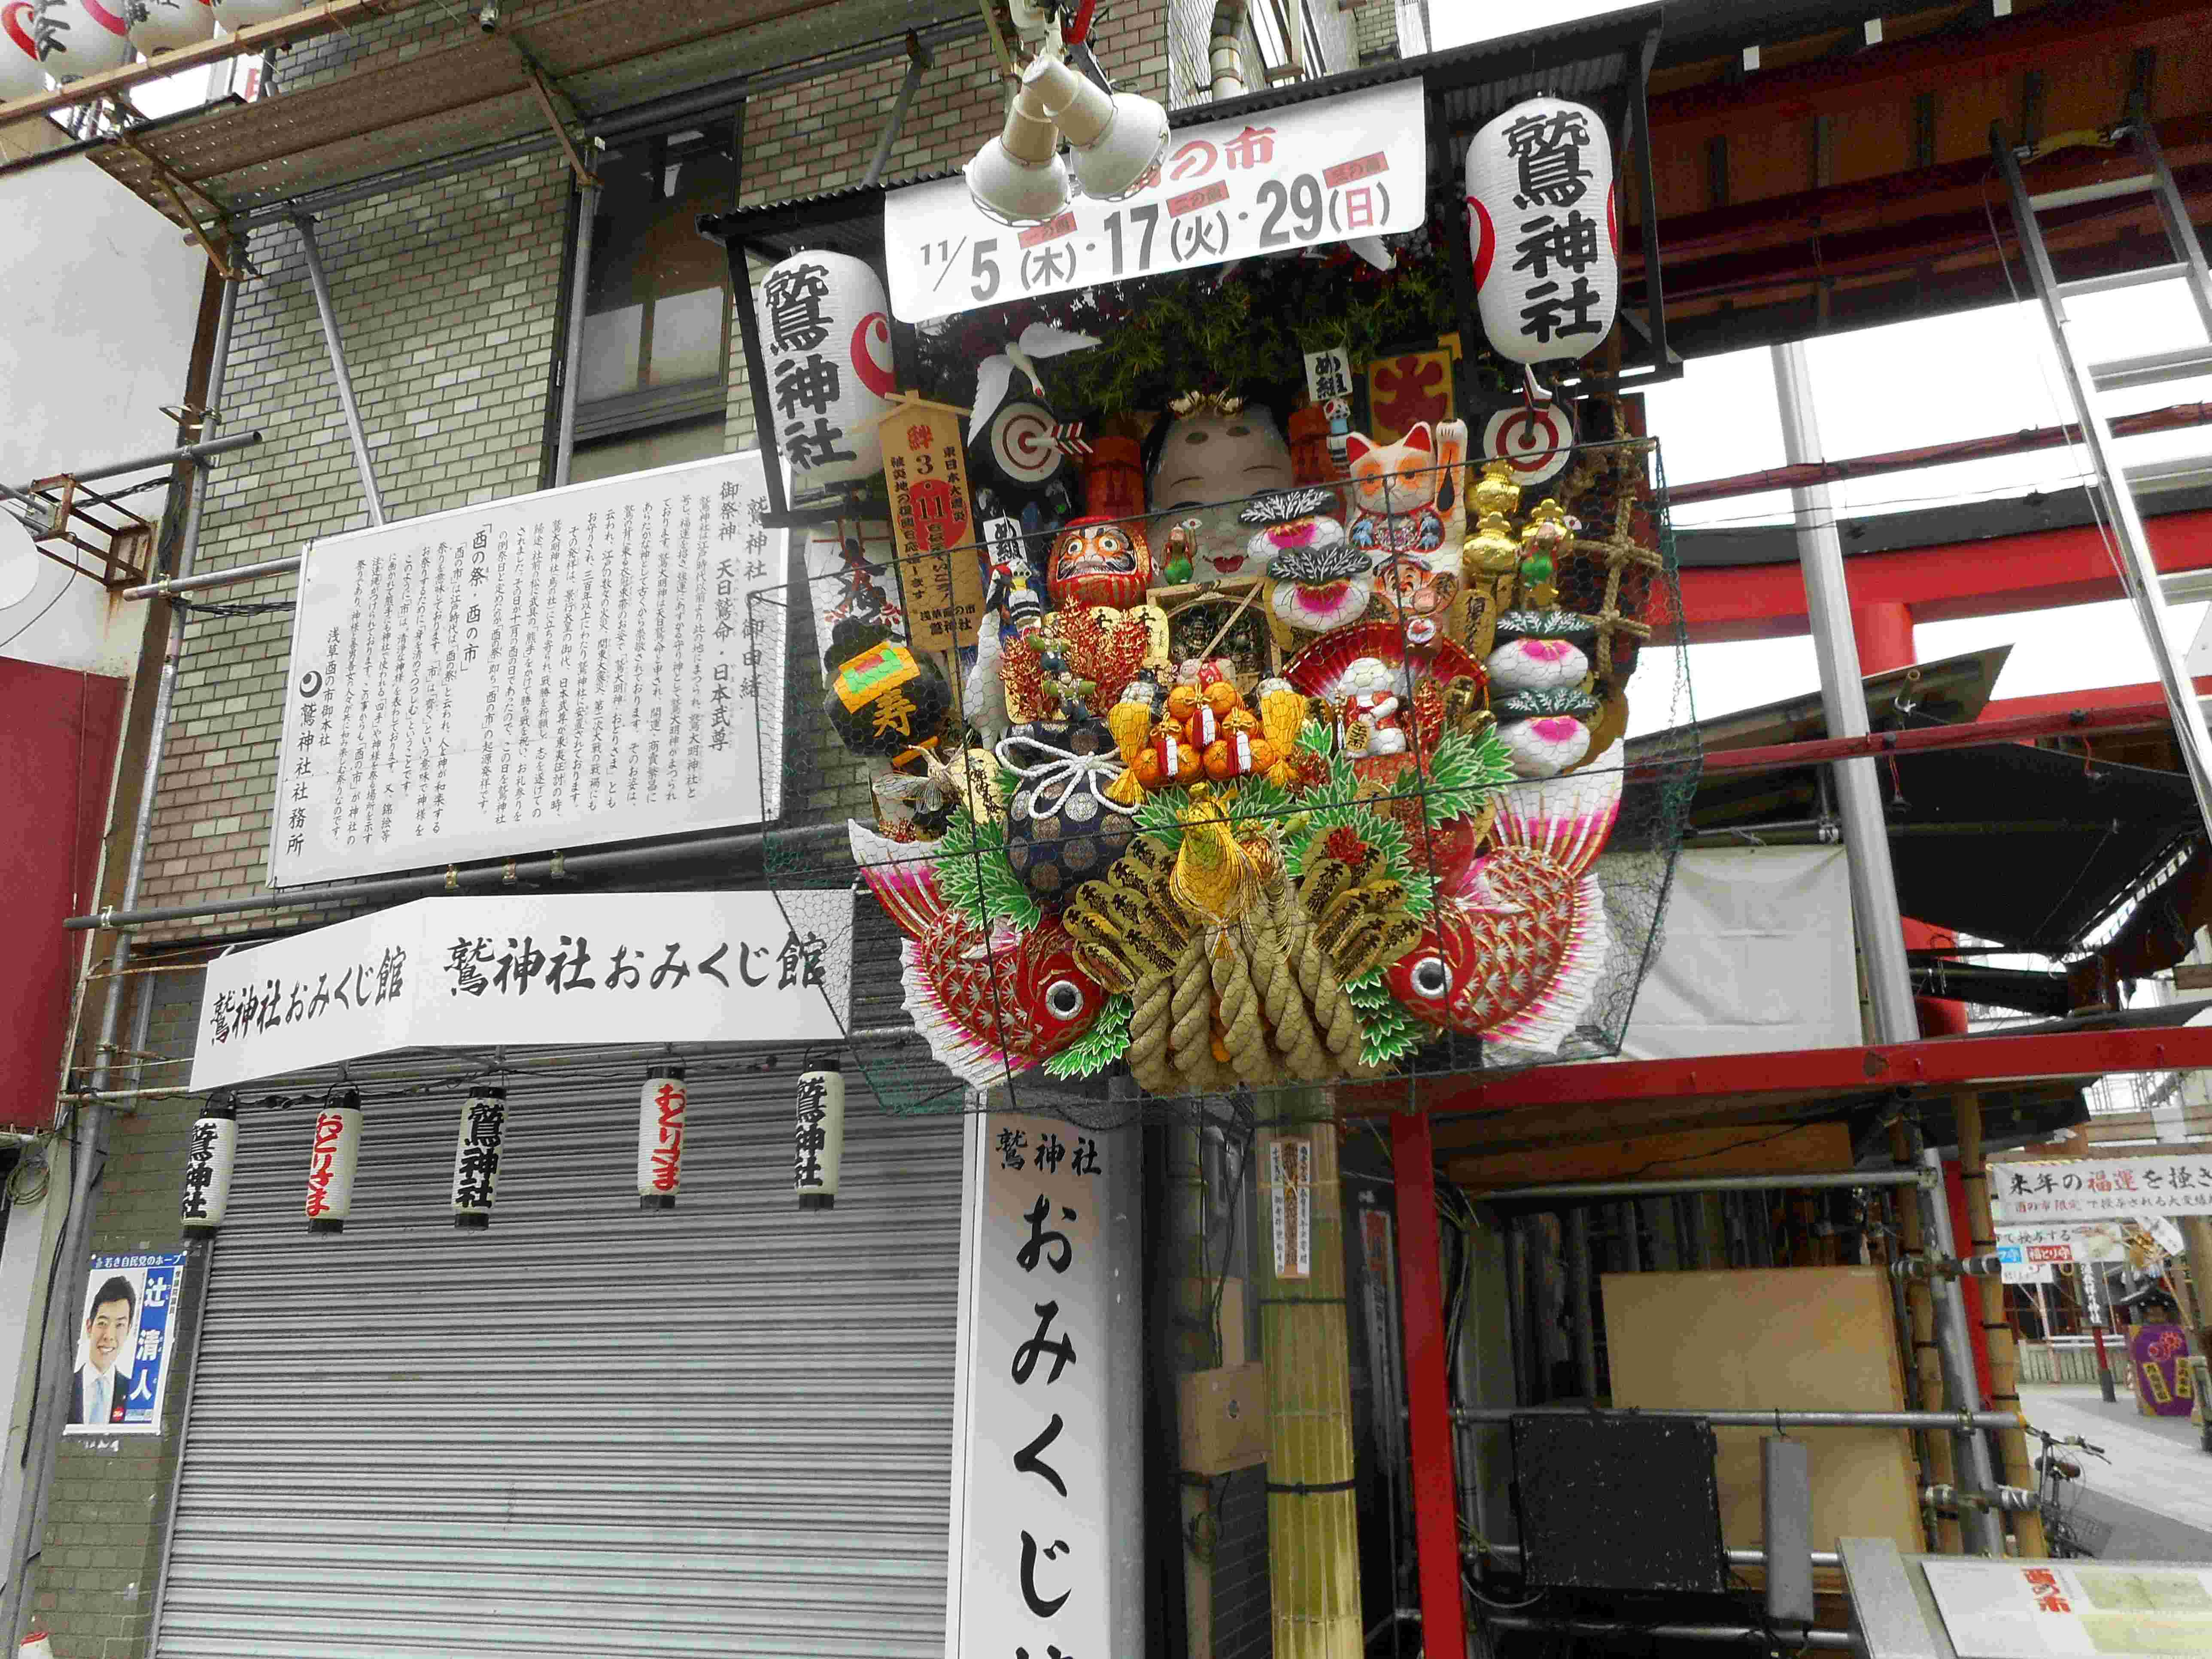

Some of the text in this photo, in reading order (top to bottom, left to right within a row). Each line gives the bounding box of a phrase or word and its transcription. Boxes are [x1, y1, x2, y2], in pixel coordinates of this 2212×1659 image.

[1502, 110, 1603, 343] 鷲神社
[763, 264, 857, 470] 鷲神社
[916, 454, 934, 474] 3
[718, 481, 738, 541] 御祭神
[916, 494, 948, 520] 11
[872, 688, 917, 738] 寿
[211, 945, 408, 1045] 鷲神社おみくじ館
[444, 933, 828, 997] 鷲神社おみくじ館
[456, 1103, 505, 1209] 鷲神社
[793, 1078, 828, 1188] 鷲神社
[996, 1127, 1102, 1176] 鷲神社
[144, 1277, 167, 1307] 辻
[1012, 1193, 1077, 1659] おみくじ
